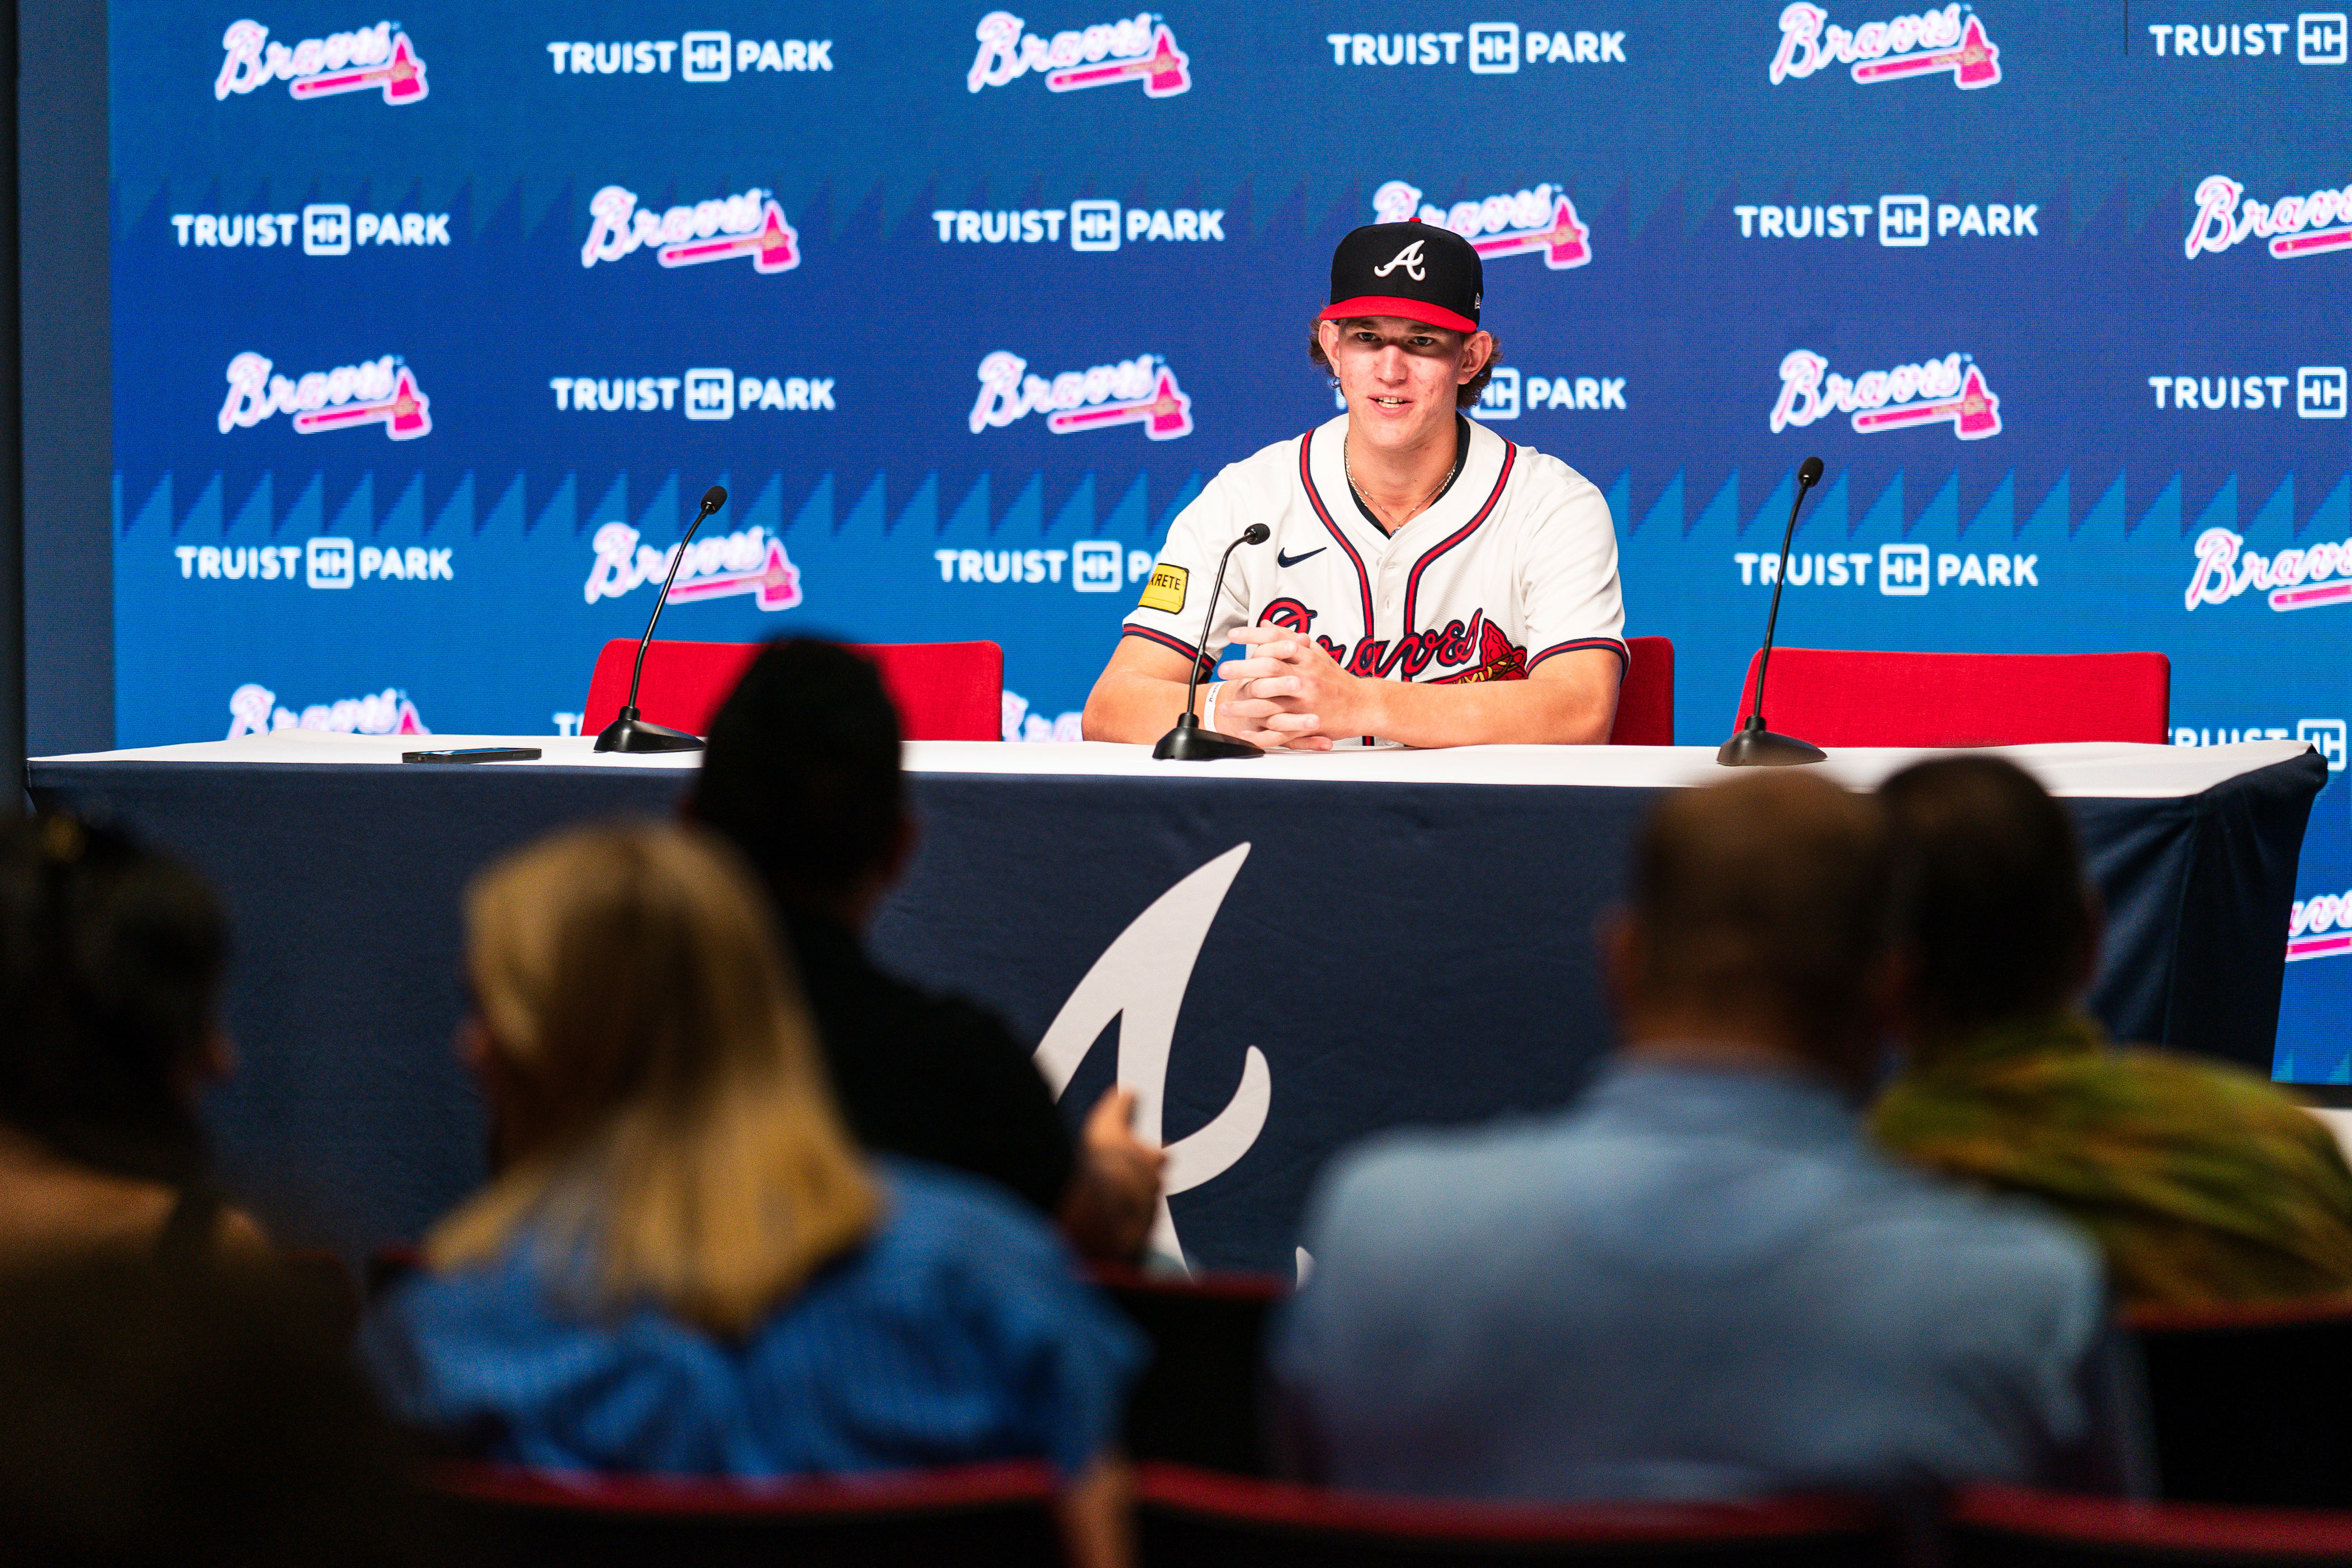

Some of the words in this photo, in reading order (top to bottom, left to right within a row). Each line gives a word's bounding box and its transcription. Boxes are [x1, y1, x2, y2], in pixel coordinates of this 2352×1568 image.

[967, 11, 1153, 93] Braves
[1327, 34, 1463, 65] TRUIST
[1526, 31, 1626, 63] PARK
[1770, 2, 1961, 85] Braves
[2148, 23, 2290, 56] TRUIST
[215, 19, 391, 101] Braves
[547, 41, 678, 74] TRUIST
[736, 40, 833, 72] PARK
[172, 214, 299, 247] TRUIST
[356, 213, 451, 246] PARK
[581, 186, 763, 268] Braves
[932, 210, 1067, 243] TRUIST
[1126, 209, 1225, 241] PARK
[1734, 205, 1873, 238] TRUIST
[1937, 204, 2039, 236] PARK
[1374, 240, 1425, 281] A
[218, 351, 395, 434] Braves
[550, 378, 681, 411] TRUIST
[739, 377, 836, 410] PARK
[969, 350, 1156, 434] Braves
[1526, 377, 1627, 410] PARK
[1770, 349, 1962, 434] Braves
[2148, 376, 2289, 409] TRUIST
[174, 546, 302, 579] TRUIST
[359, 547, 454, 580] PARK
[584, 522, 765, 605] Braves
[934, 549, 1068, 582] TRUIST
[1734, 553, 1873, 586] TRUIST
[1937, 553, 2039, 586] PARK
